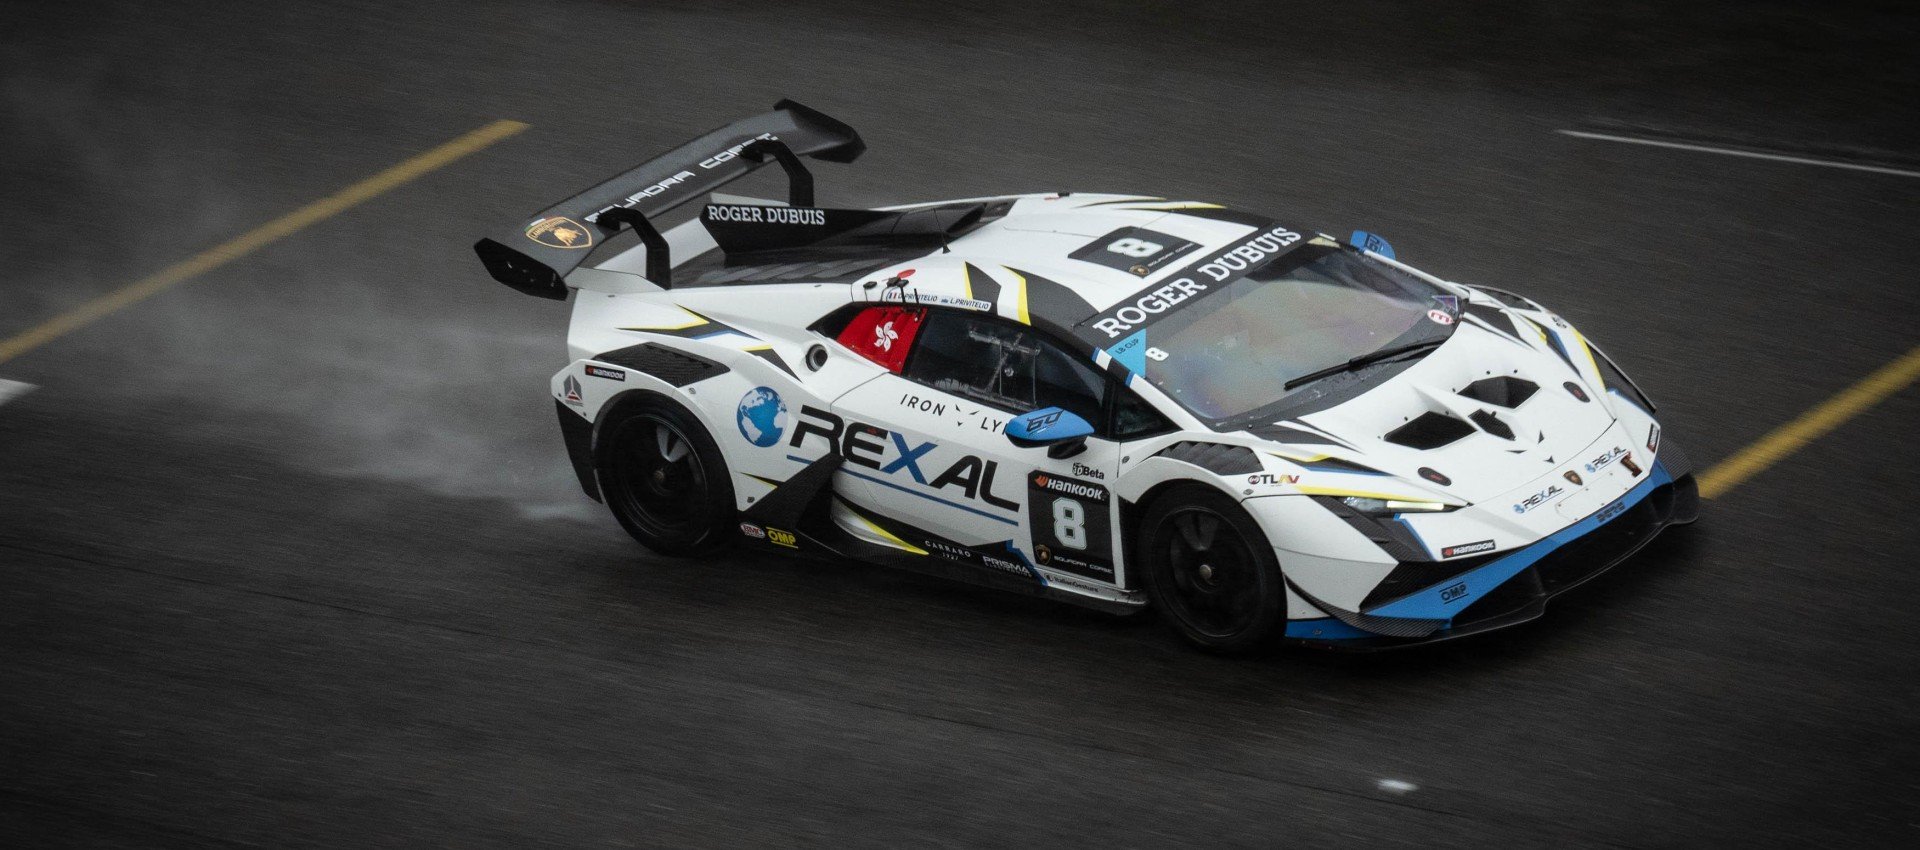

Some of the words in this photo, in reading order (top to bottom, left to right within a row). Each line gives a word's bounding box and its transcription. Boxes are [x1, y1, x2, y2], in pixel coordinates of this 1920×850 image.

[707, 205, 764, 223] ROGER
[765, 207, 826, 226] DUBUIS
[1106, 237, 1164, 258] 8
[1092, 277, 1207, 338] ROGER
[1197, 226, 1302, 282] DUBUIS
[1124, 338, 1139, 349] CUP
[1145, 347, 1170, 362] 8
[900, 393, 946, 416] IRON
[980, 416, 1008, 436] LY
[789, 404, 1021, 513] REXAL
[1521, 485, 1563, 509] REXAL
[1052, 496, 1088, 551] 8
[767, 529, 797, 545] OMP
[924, 540, 972, 558] CARRARO
[982, 555, 1031, 575] PRISMA
[1441, 584, 1467, 601] OMP
